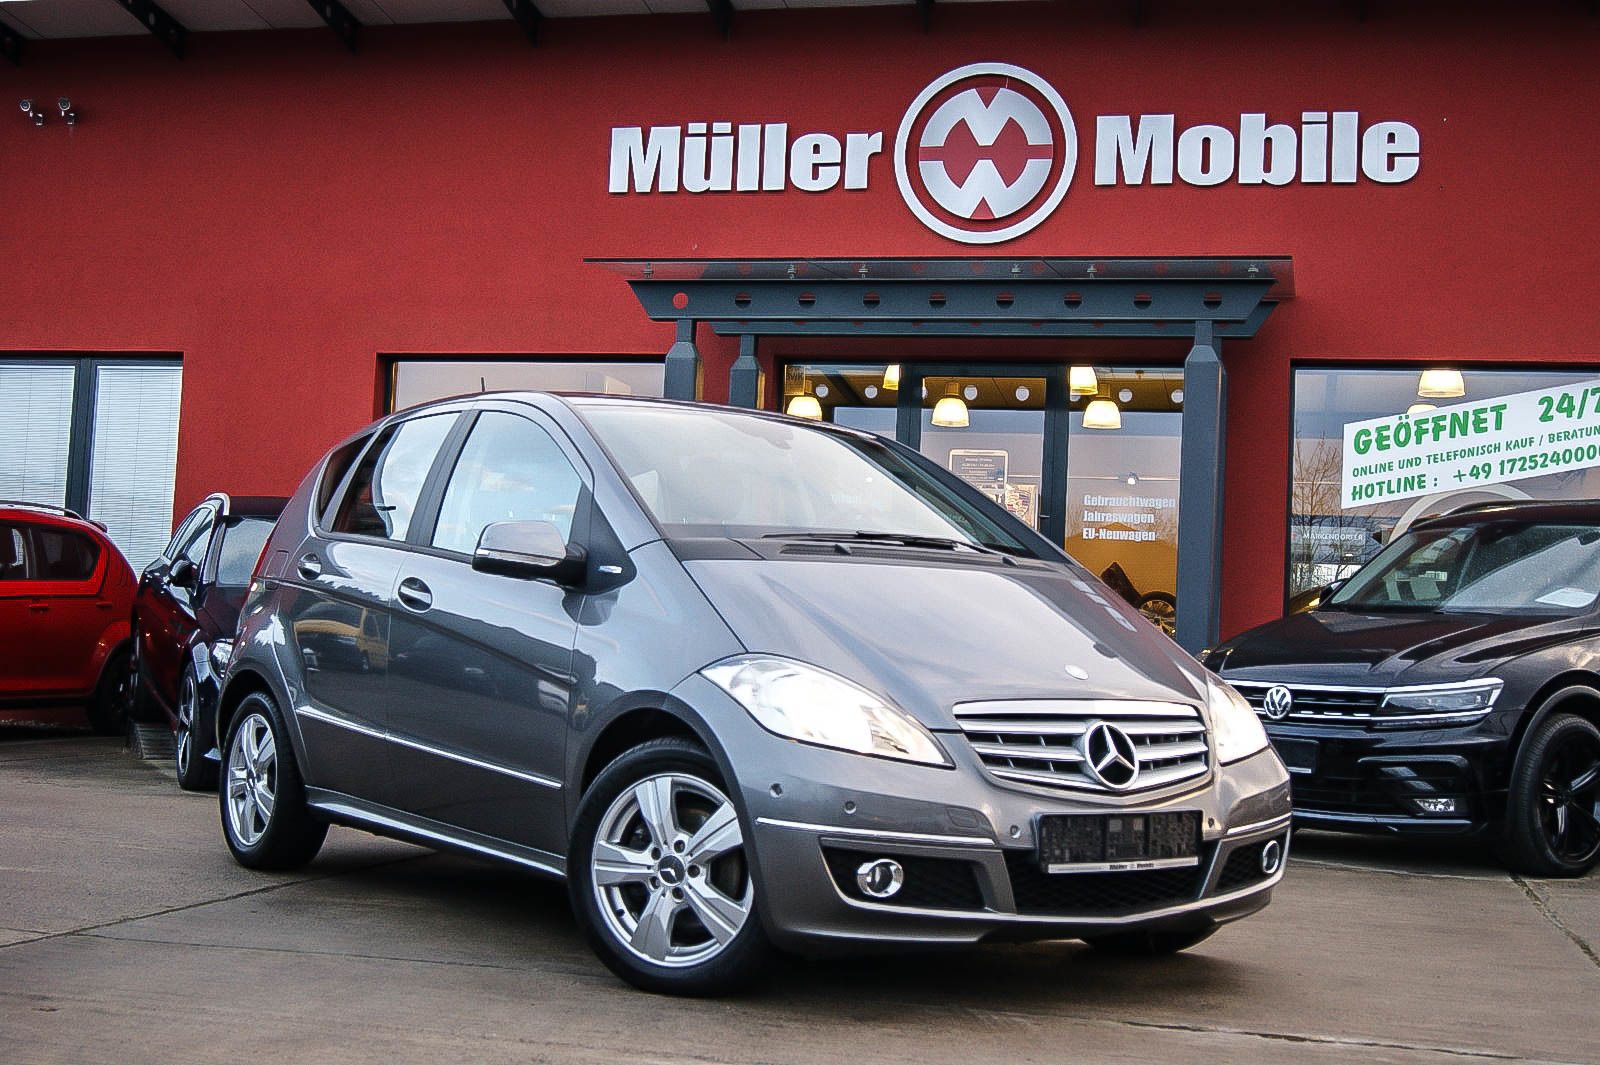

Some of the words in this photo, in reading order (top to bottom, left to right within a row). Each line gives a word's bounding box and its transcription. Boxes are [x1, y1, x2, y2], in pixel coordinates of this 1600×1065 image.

[608, 122, 882, 193] Müller
[1095, 111, 1420, 186] Mobile
[1353, 404, 1507, 455] GEÖFFNET
[1351, 473, 1427, 501] HOTLINE
[1453, 462, 1492, 483] +49
[1499, 443, 1600, 476] 172524000
[1352, 461, 1394, 477] ONLINE
[1398, 456, 1422, 470] UND
[1426, 442, 1501, 465] TELEFONISCH
[1505, 435, 1535, 451] KAUF
[1083, 510, 1154, 524] Jahreswagen
[1084, 495, 1175, 508] Gebrauchtwagen
[1083, 528, 1155, 541] EU-Neuwagen
